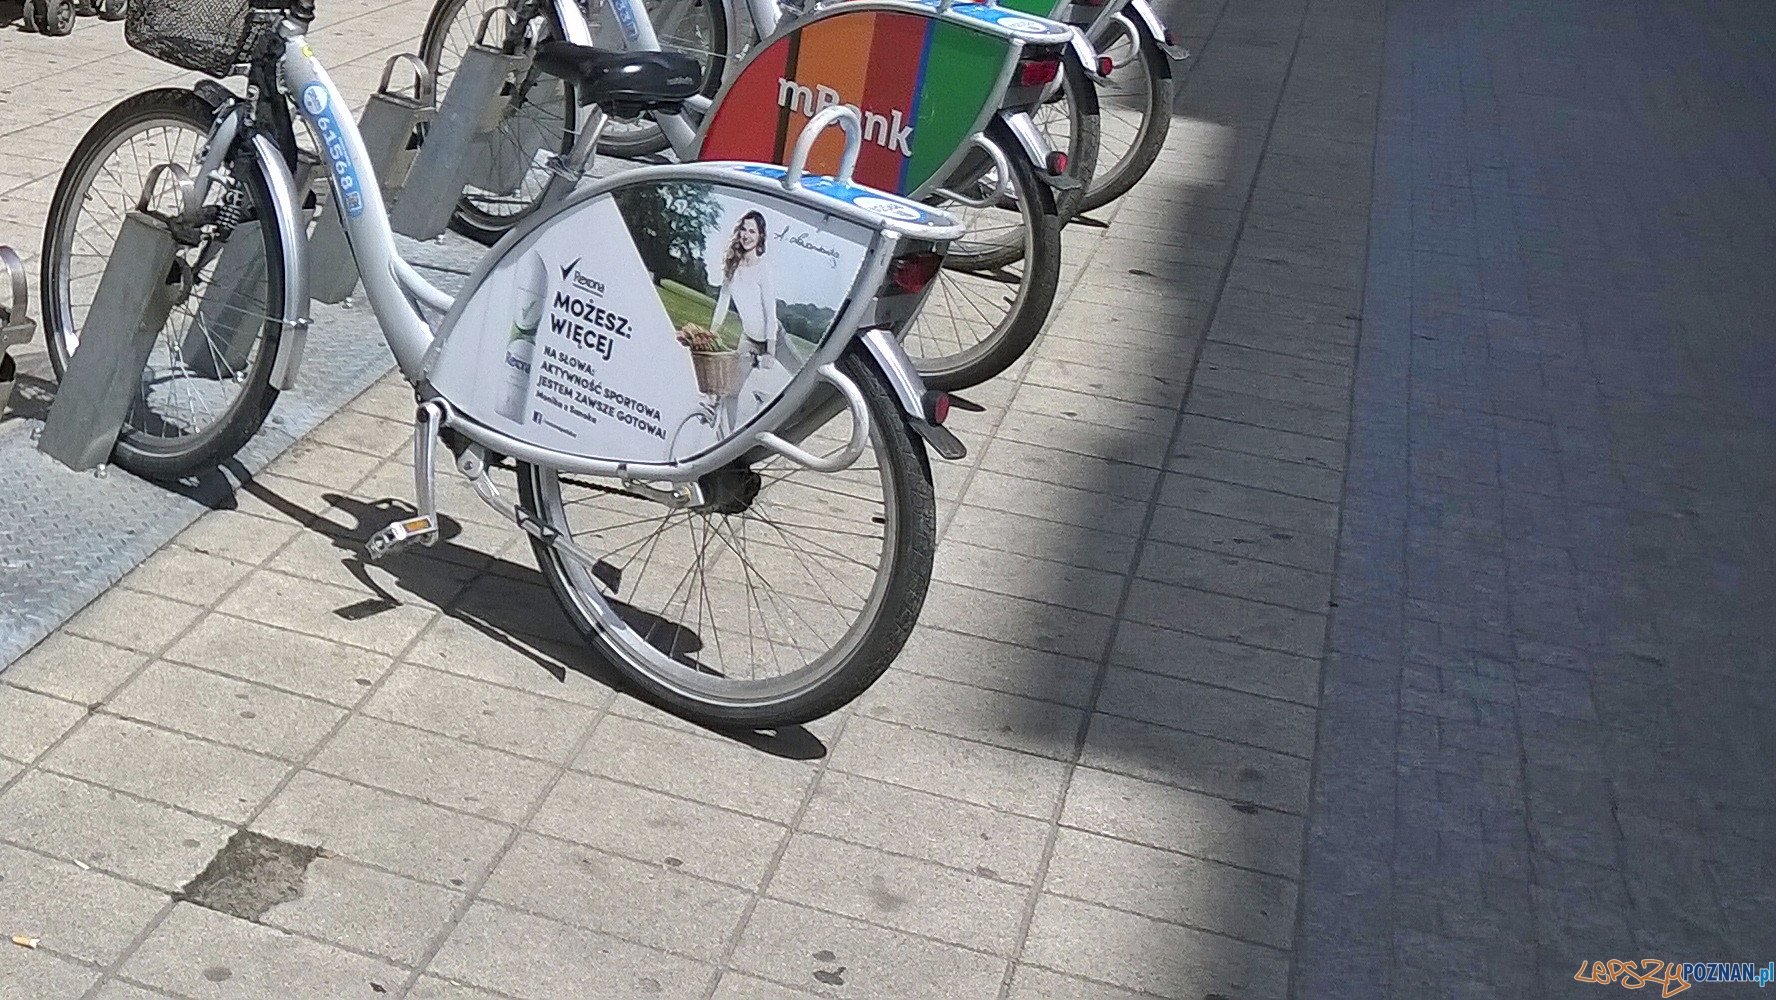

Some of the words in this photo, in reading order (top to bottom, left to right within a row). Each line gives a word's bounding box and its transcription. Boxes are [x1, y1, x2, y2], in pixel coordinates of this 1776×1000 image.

[317, 117, 354, 191] 61568
[573, 270, 605, 294] Rexona
[550, 312, 614, 361] WIĘCEJ
[553, 291, 633, 340] MOŻESZ:
[544, 345, 557, 360] NA
[536, 374, 574, 399] JESTEM
[575, 390, 616, 418] ZAWSZE
[616, 410, 667, 440] GOTOWA!
[540, 360, 603, 396] AKTYWNOŚĆ
[603, 387, 662, 422] SPORTOWA
